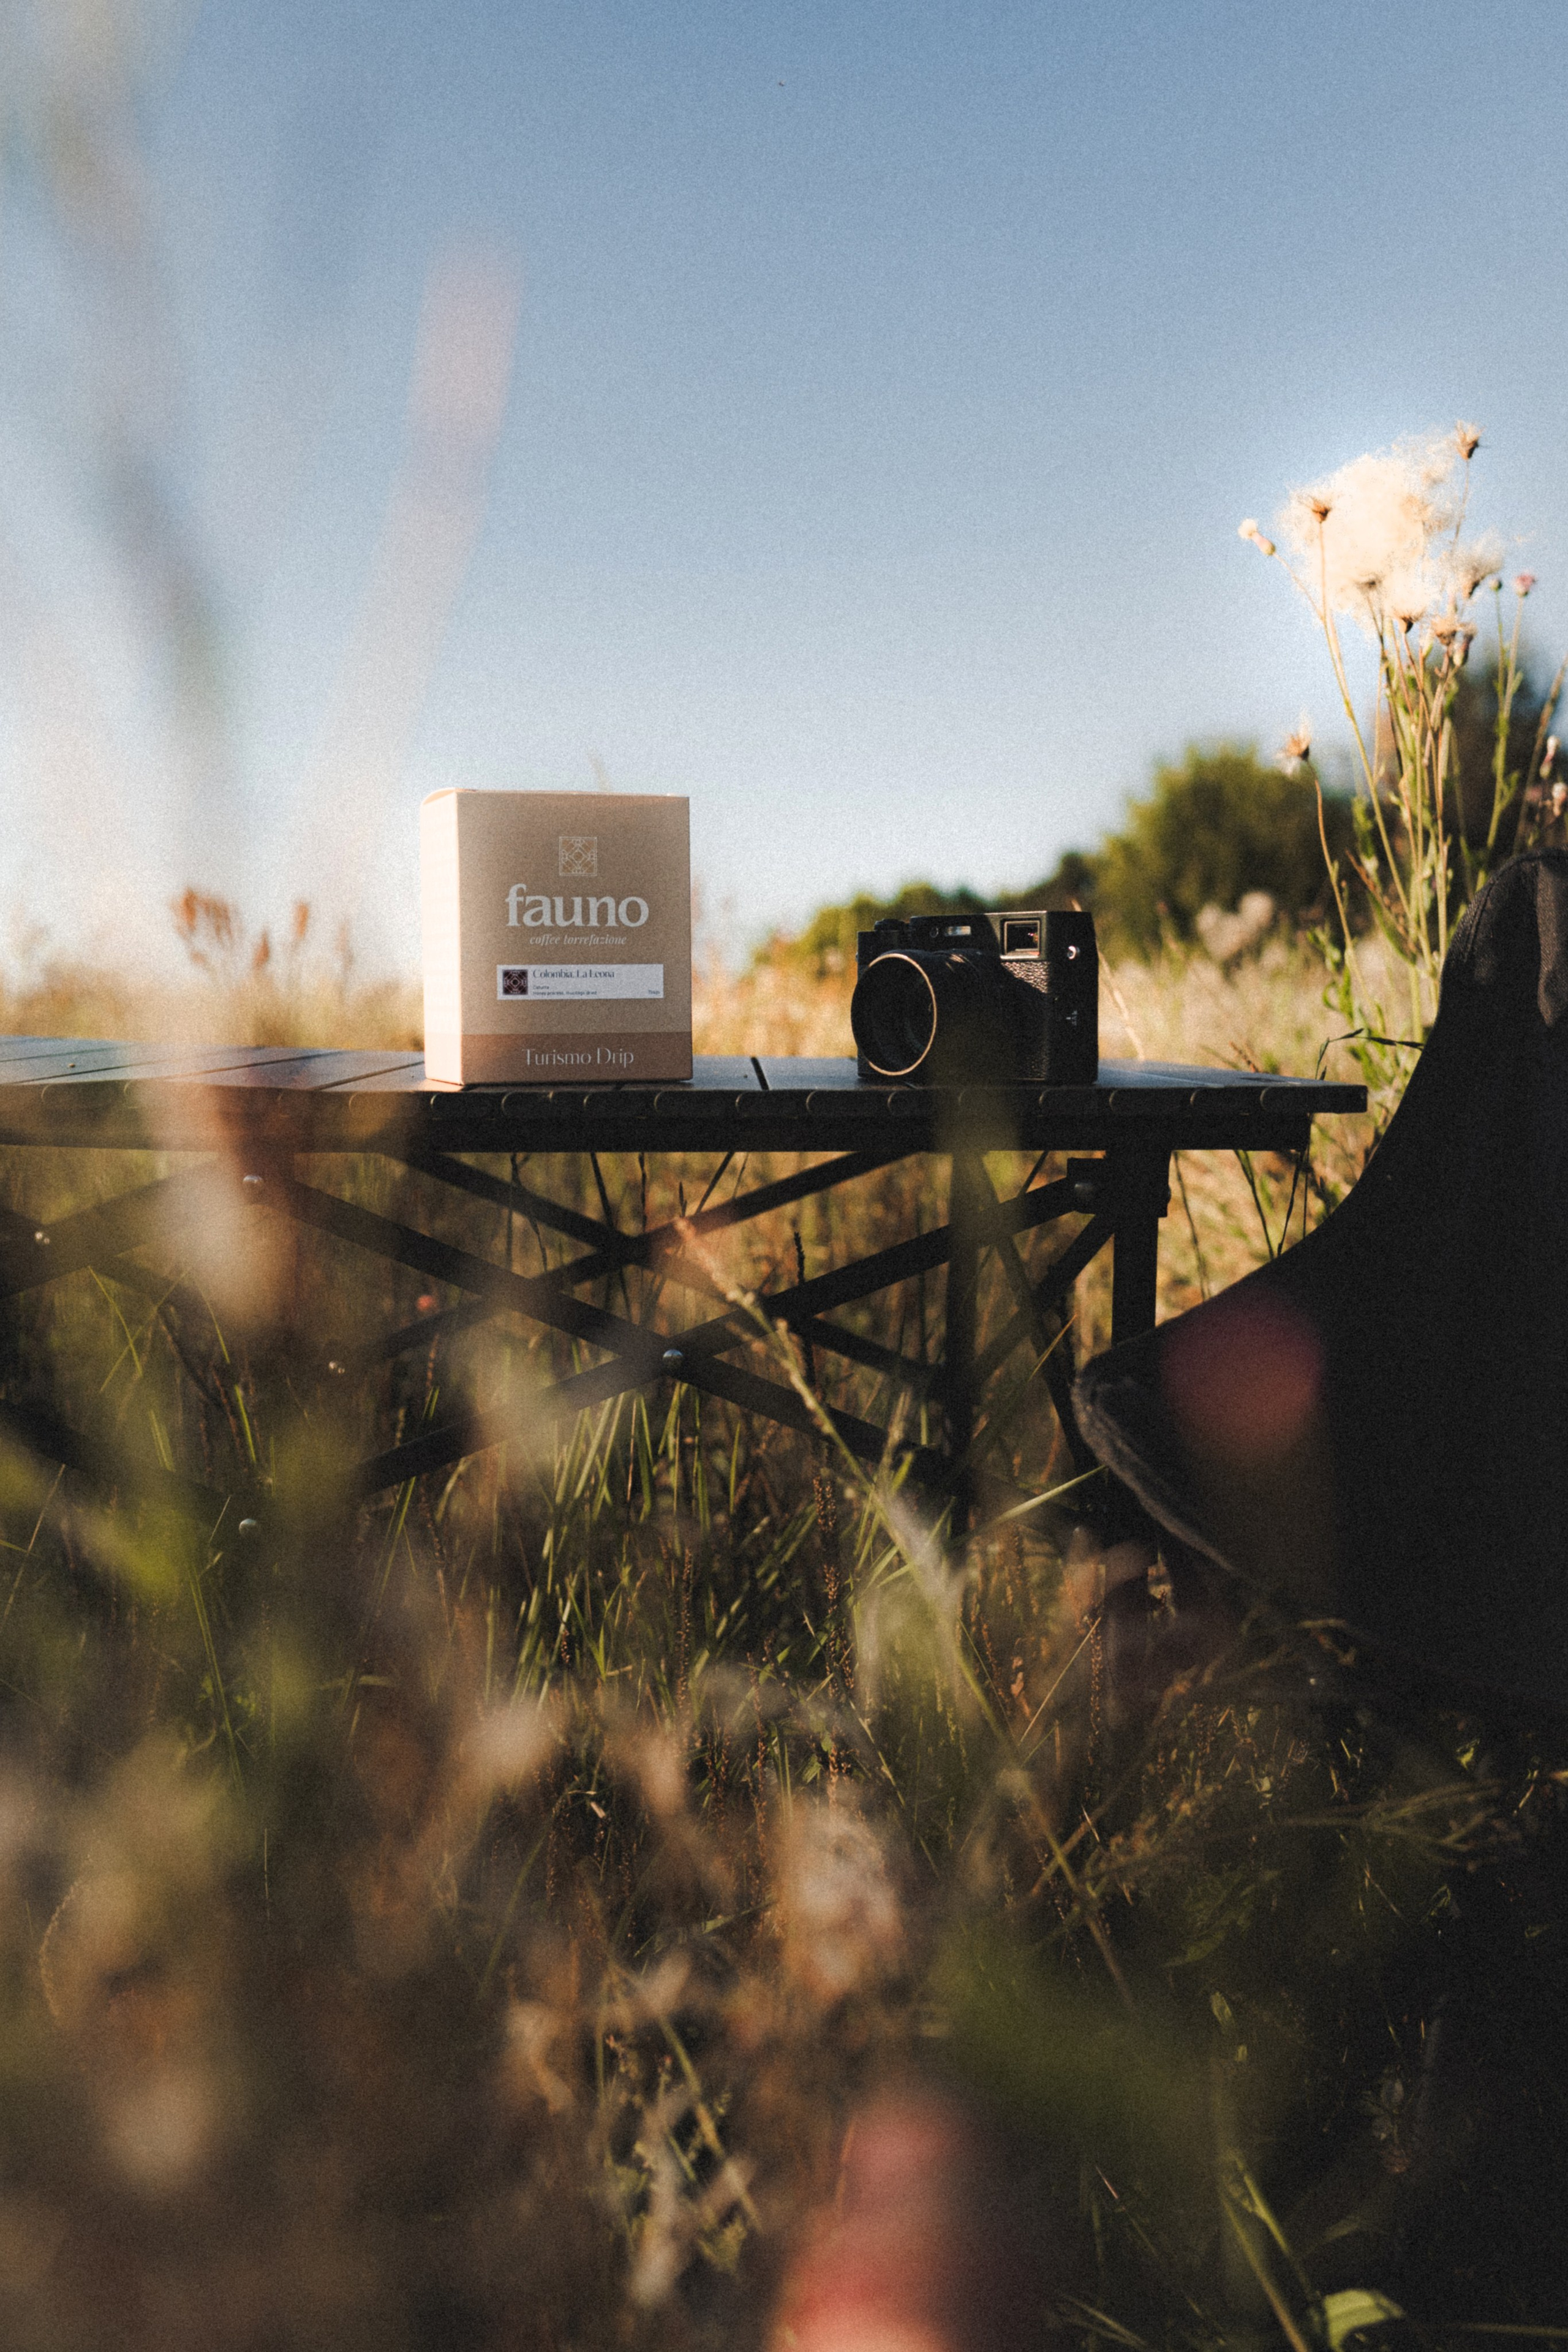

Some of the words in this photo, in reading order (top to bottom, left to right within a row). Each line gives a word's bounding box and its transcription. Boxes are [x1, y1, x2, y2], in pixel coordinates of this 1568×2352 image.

[506, 883, 649, 927] fauno
[530, 934, 559, 946] coffee
[564, 934, 627, 946] torrefazione
[576, 969, 587, 978] La
[589, 969, 614, 978] Leona
[522, 1048, 592, 1066] Turismo
[597, 1048, 634, 1068] Drip
